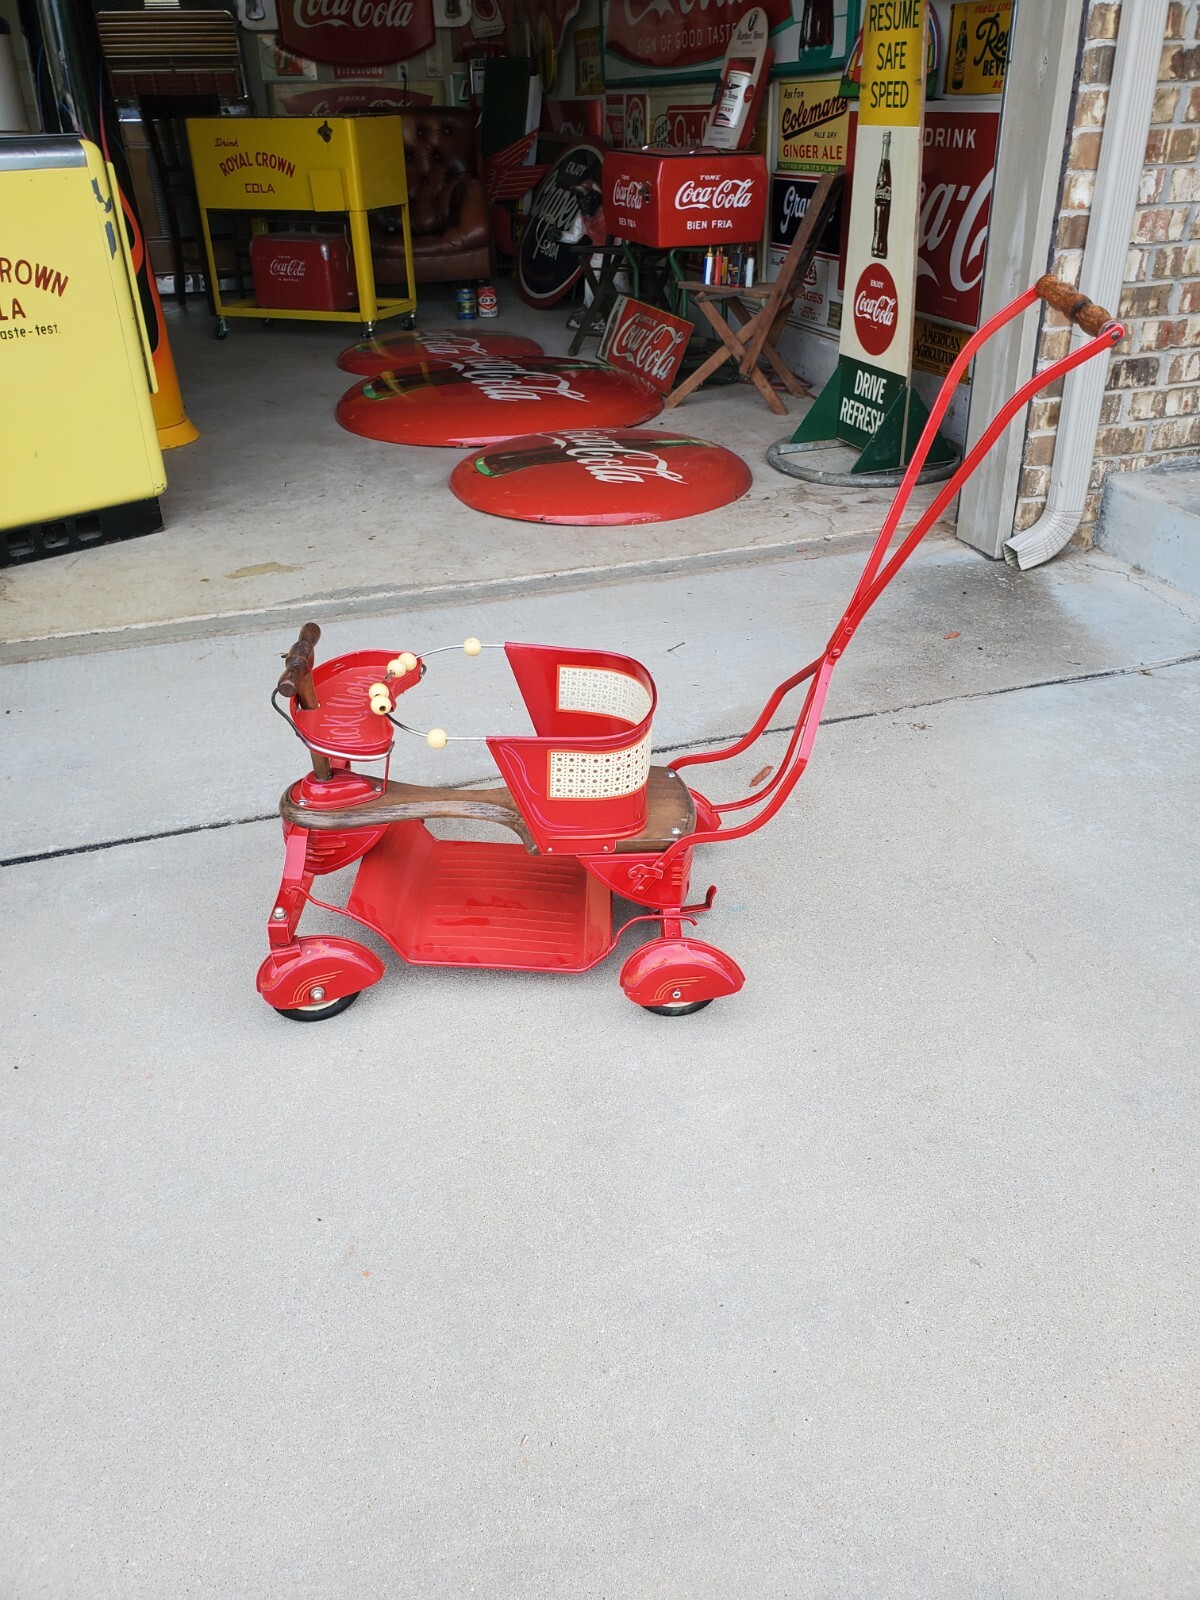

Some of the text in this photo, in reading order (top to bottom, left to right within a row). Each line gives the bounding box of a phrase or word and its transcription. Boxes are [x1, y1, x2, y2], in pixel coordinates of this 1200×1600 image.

[293, 0, 413, 28] CocaCola
[869, 0, 919, 31] RESUME
[638, 37, 657, 55] SIGN
[660, 34, 673, 52] OF
[674, 29, 703, 49] GOOD
[876, 41, 907, 71] SAFE
[870, 80, 909, 108] SPEED
[214, 137, 239, 147] Drink
[923, 127, 977, 149] DRINK
[219, 151, 296, 178] ROYAL CROWN
[783, 144, 843, 160] GINGER ALE
[565, 161, 588, 177] ENJOY
[244, 183, 275, 193] COLA
[674, 178, 755, 210] Coca-Cola
[687, 219, 733, 230] BIEN FRIA
[0, 257, 69, 297] ROWN
[870, 279, 884, 289] ENJOY
[638, 314, 660, 328] DRINK
[855, 290, 897, 326] Coca-Cola
[613, 312, 686, 380] Coca-Cola
[920, 325, 962, 350] AMERICAN
[854, 369, 887, 404] DRIVE
[839, 397, 885, 434] REFRESH
